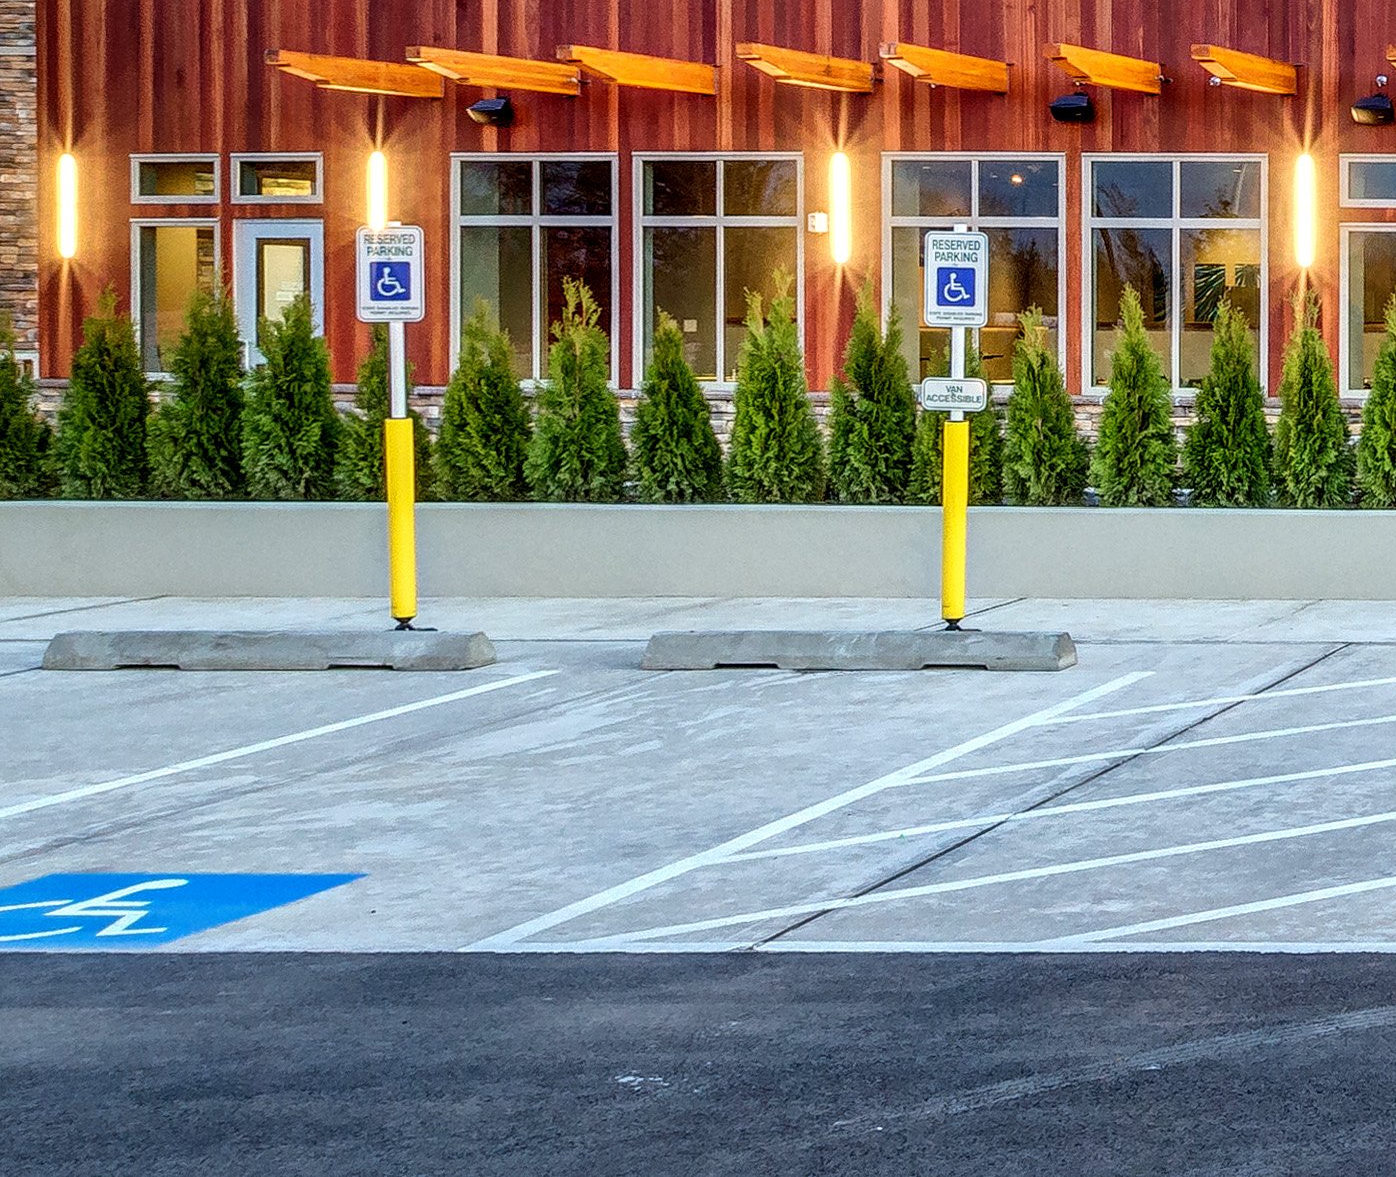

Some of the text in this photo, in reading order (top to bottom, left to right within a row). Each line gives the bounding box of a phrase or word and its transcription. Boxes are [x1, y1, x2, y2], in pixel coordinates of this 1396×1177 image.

[364, 234, 416, 244] RESERVED
[932, 239, 981, 251] RESERVED
[367, 246, 413, 256] PARKING
[934, 251, 978, 262] PARKING
[945, 385, 963, 393] VAN
[926, 394, 982, 404] ACCESSIBLE
